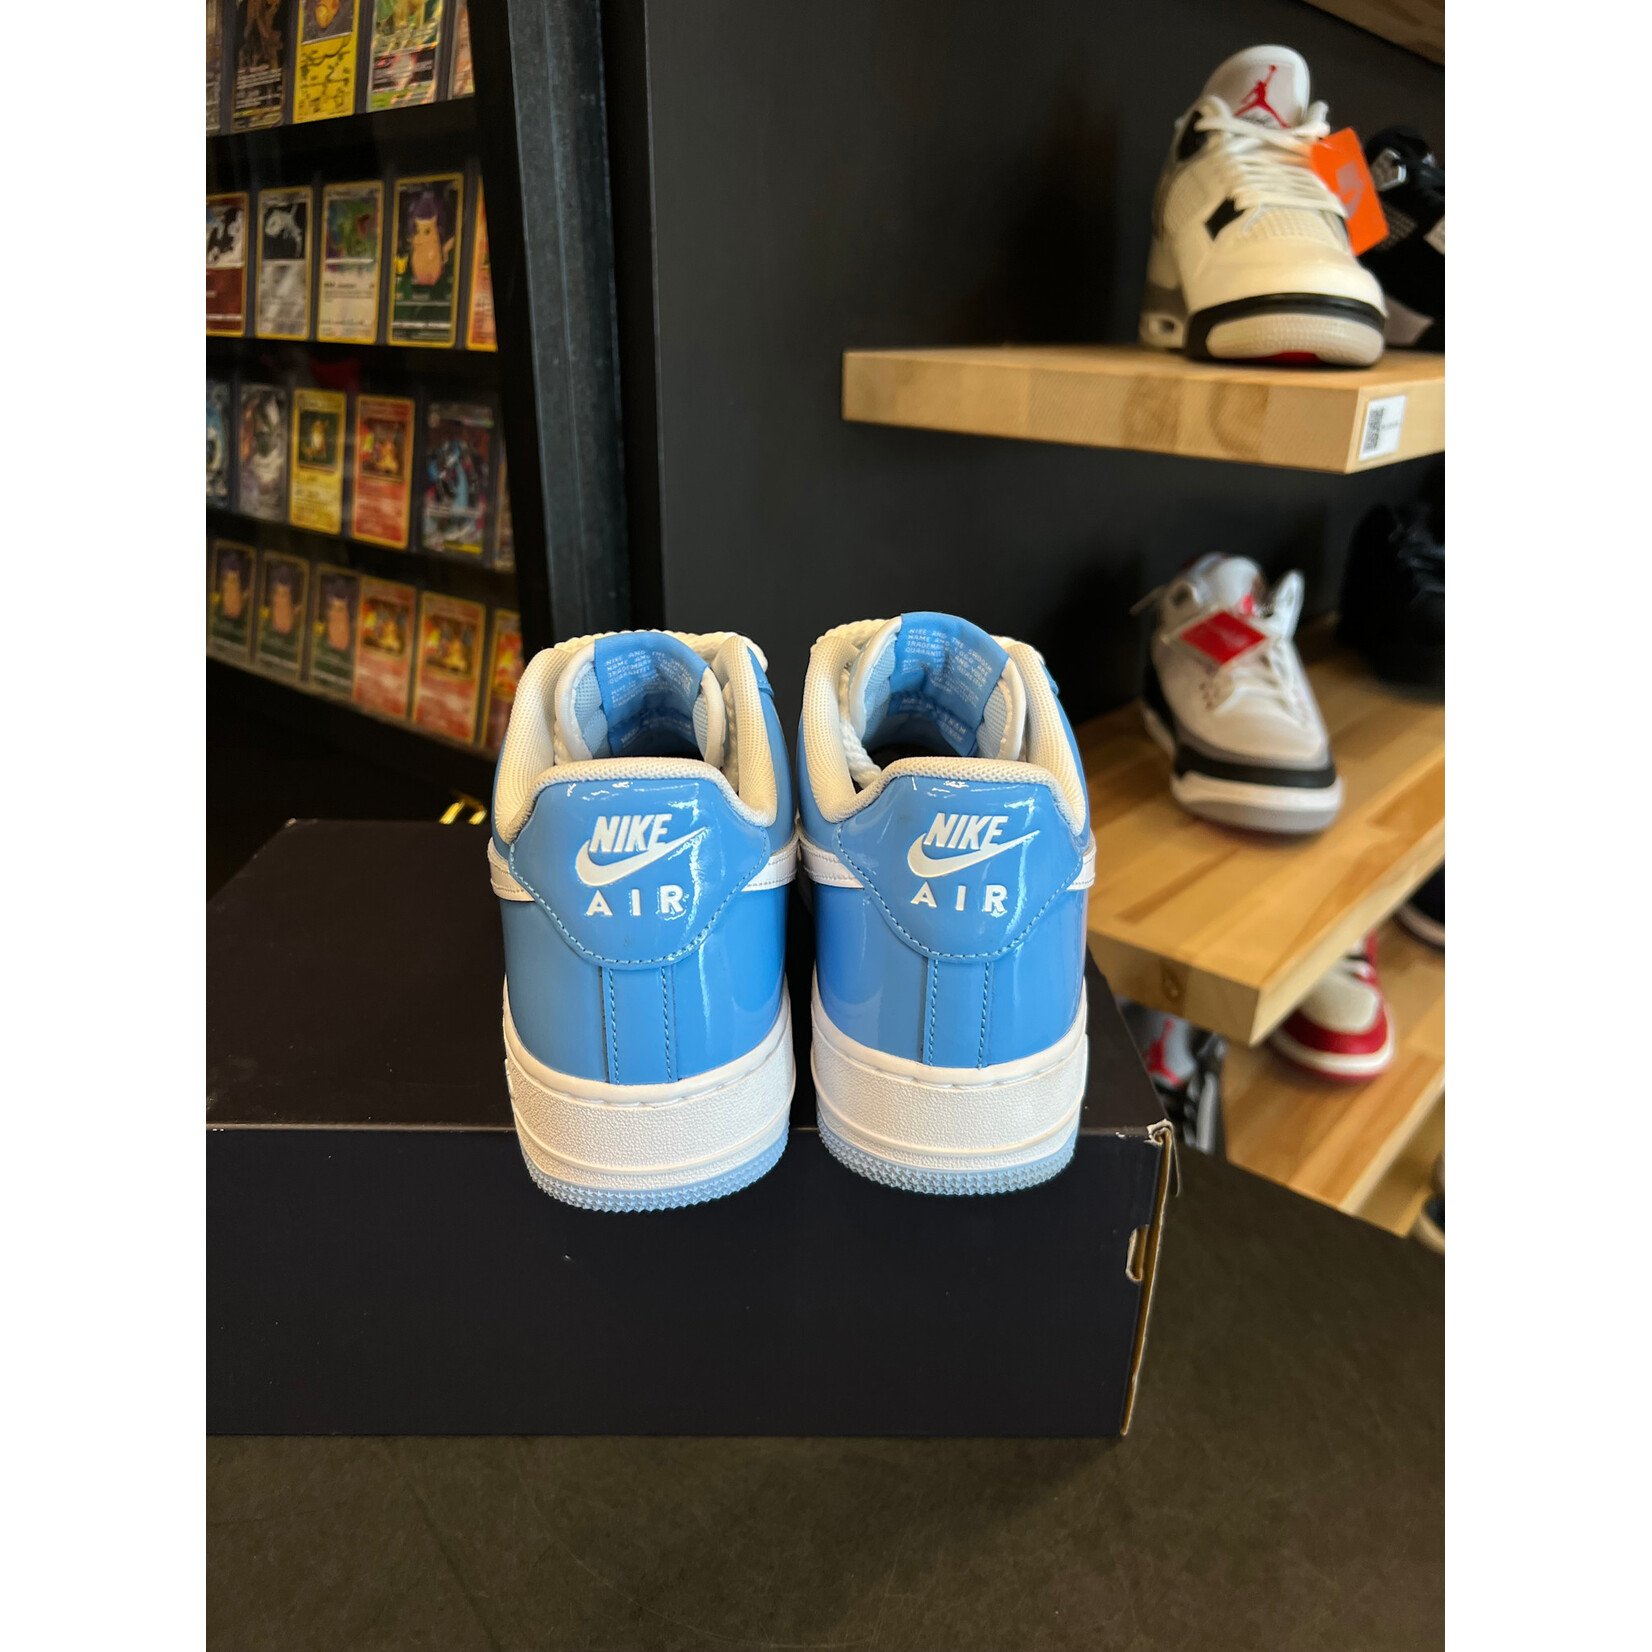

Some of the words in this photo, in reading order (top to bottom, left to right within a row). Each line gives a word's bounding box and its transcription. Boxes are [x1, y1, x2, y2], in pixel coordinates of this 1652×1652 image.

[588, 813, 673, 853] NIKE
[923, 812, 1009, 850] NIKE
[585, 884, 684, 917] AIR
[910, 880, 1008, 912] AIR
